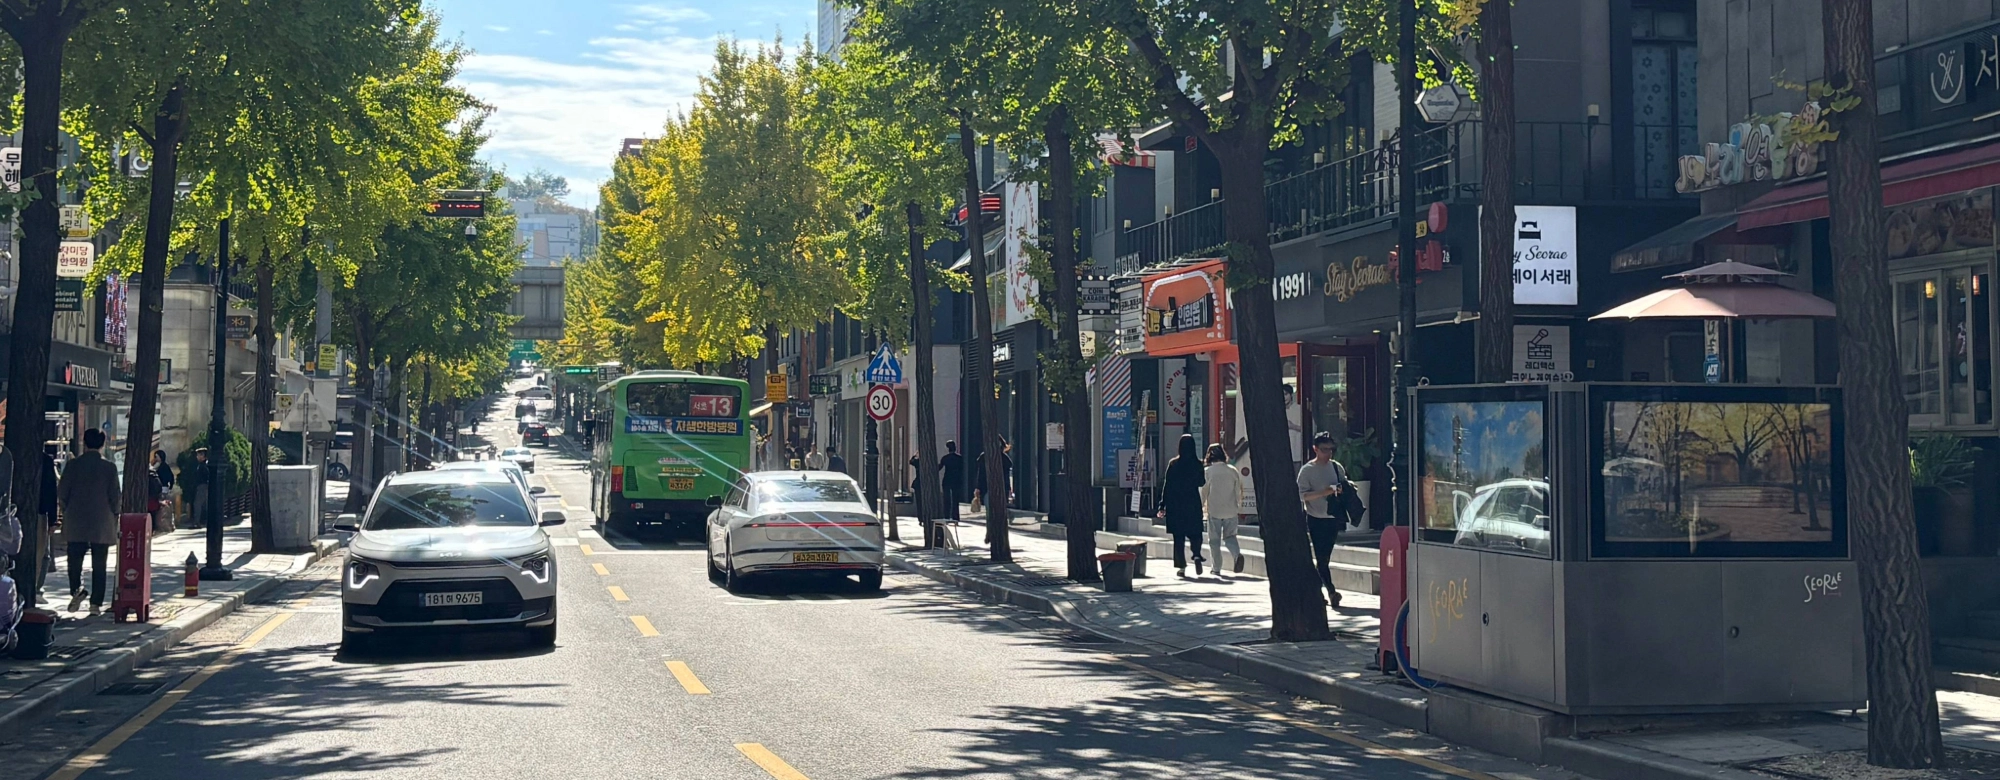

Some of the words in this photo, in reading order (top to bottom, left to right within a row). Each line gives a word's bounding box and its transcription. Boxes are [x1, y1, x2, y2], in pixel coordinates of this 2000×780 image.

[1525, 245, 1568, 260] Seorae
[1324, 262, 1347, 302] Stay
[1349, 256, 1389, 291] Seorae
[1540, 269, 1571, 285] 서래
[1088, 287, 1104, 295] COIN
[1279, 272, 1305, 300] 1991
[1178, 294, 1209, 329] 인형뽑기
[709, 398, 732, 416] 13
[872, 395, 890, 410] 30
[1803, 571, 1842, 603] SEORAE
[455, 592, 480, 604] 9675
